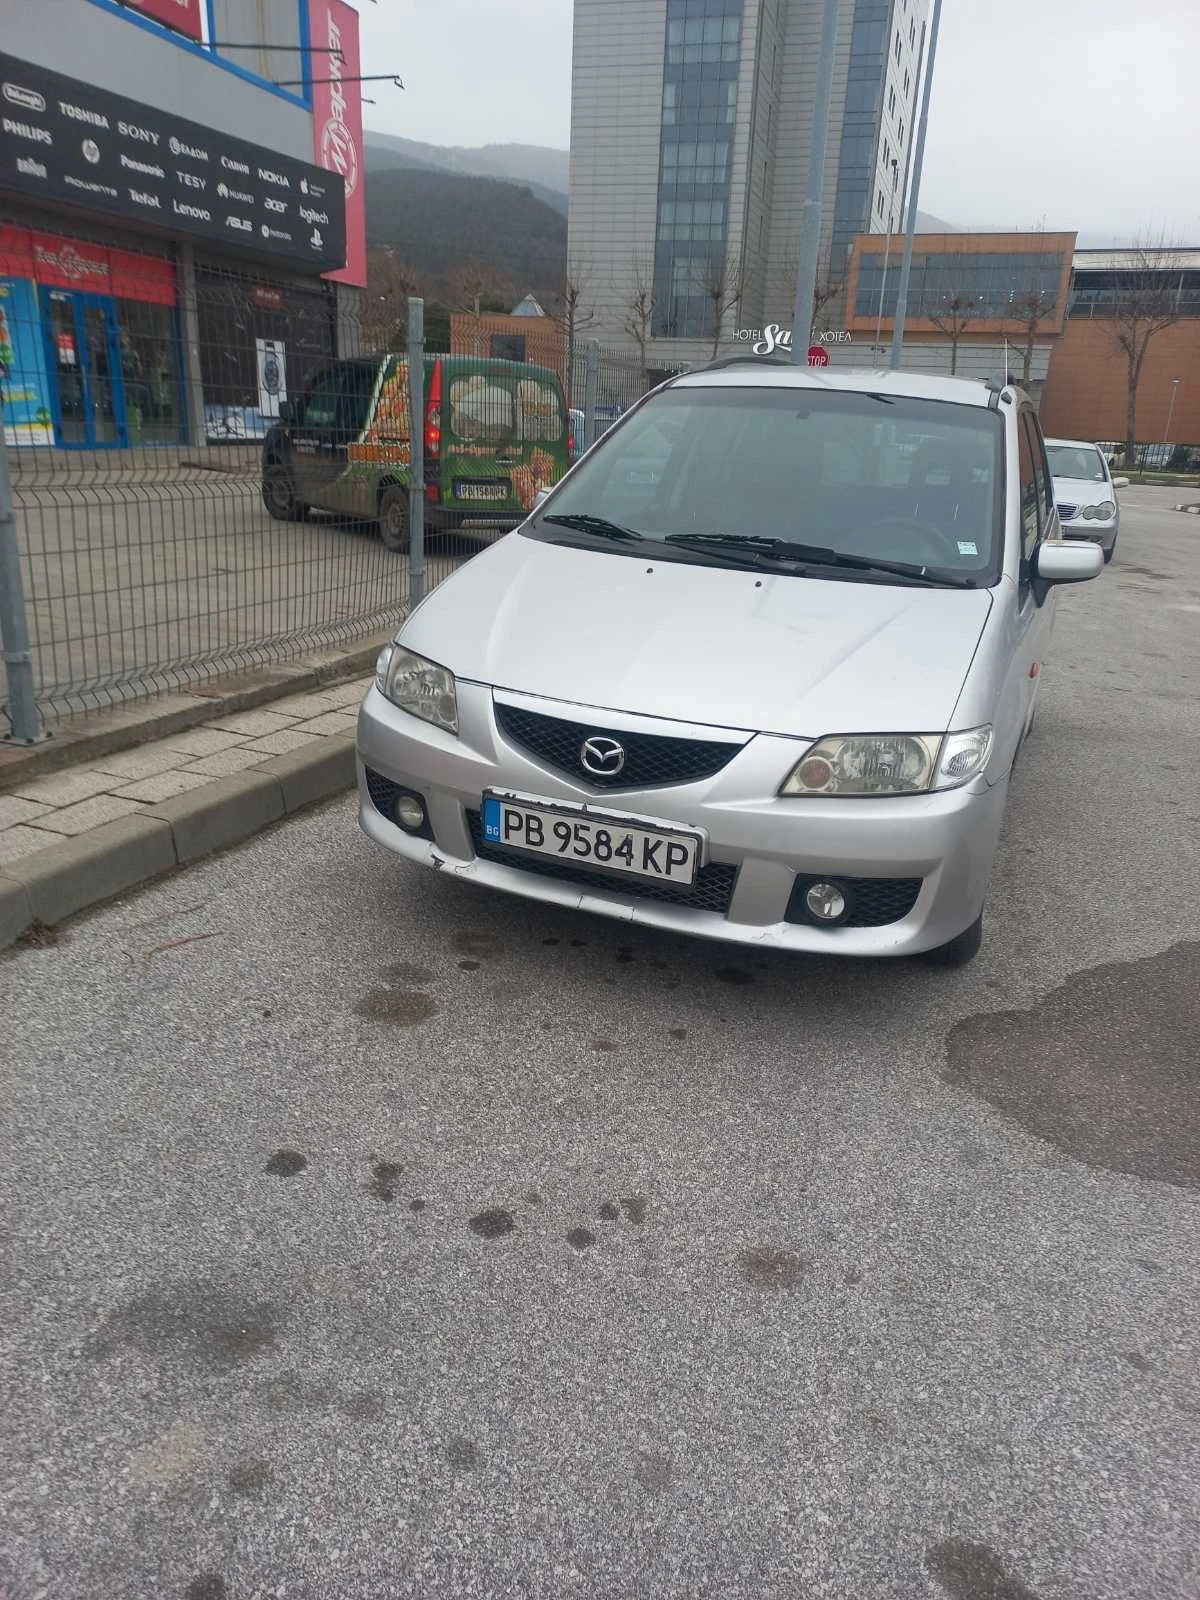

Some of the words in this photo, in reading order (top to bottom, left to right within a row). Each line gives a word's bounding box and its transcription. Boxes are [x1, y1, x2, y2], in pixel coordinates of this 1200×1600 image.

[58, 101, 109, 129] TOSHIBA
[2, 118, 53, 145] PHILIPS
[117, 121, 160, 145] SONY
[120, 154, 165, 178] Panasonic
[176, 171, 206, 190] TESY
[258, 168, 290, 188] NOKIA
[128, 188, 161, 208] Tefal
[264, 197, 288, 213] acer
[173, 199, 211, 221] Lenovo
[299, 205, 329, 225] logitech
[225, 216, 253, 231] ASUS
[732, 329, 763, 341] HOTEL
[486, 824, 499, 838] BG
[503, 808, 545, 848] PB
[552, 820, 635, 867] 9584
[641, 836, 690, 876] KP
